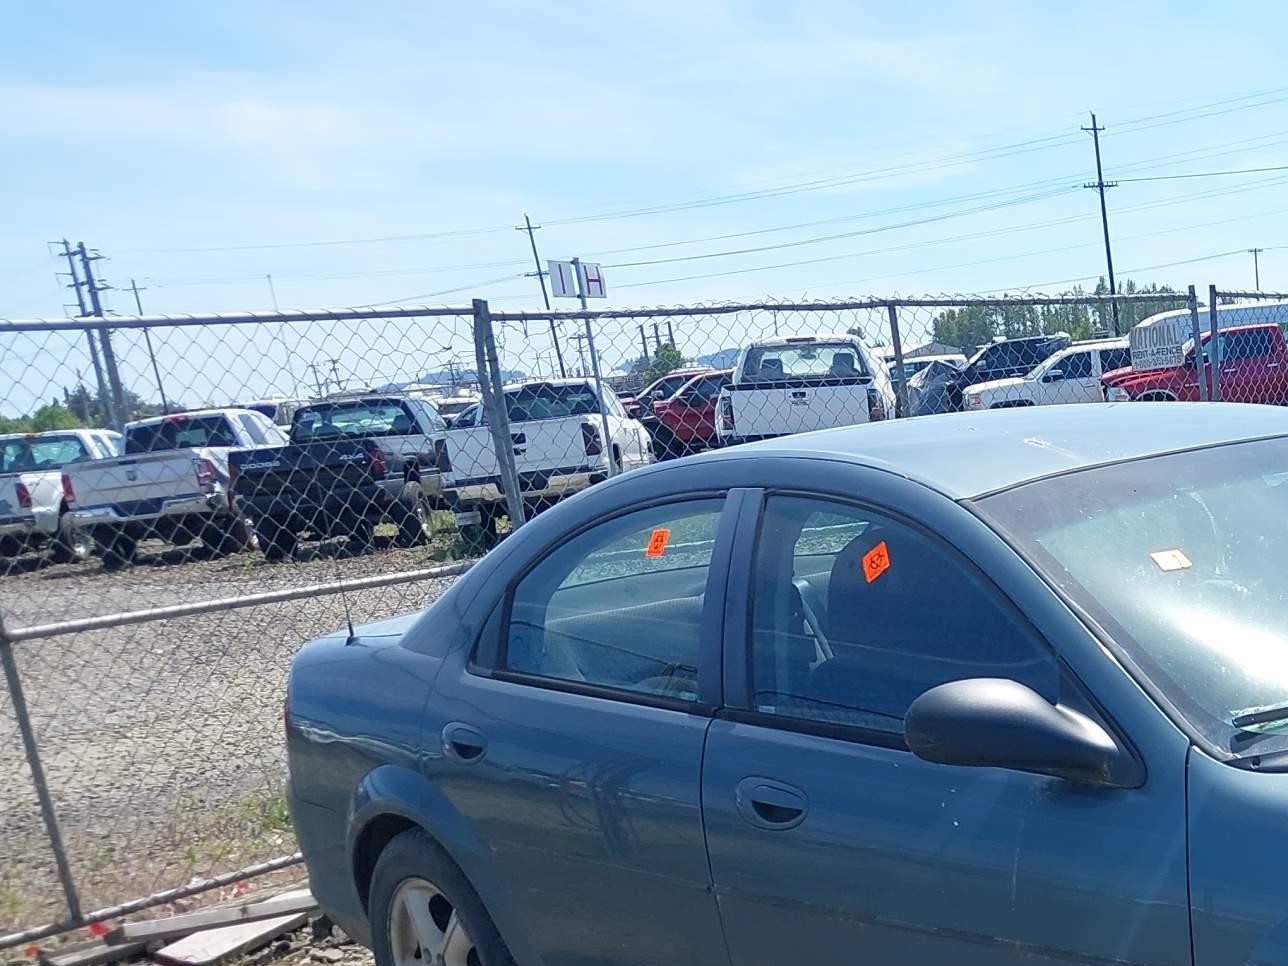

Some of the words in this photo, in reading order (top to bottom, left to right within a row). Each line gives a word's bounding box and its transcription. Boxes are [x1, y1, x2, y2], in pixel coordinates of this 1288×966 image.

[583, 264, 603, 295] H
[1130, 324, 1180, 351] NATIONAL
[1132, 345, 1182, 360] RENT-A-FENCE
[240, 461, 280, 470] DODGE
